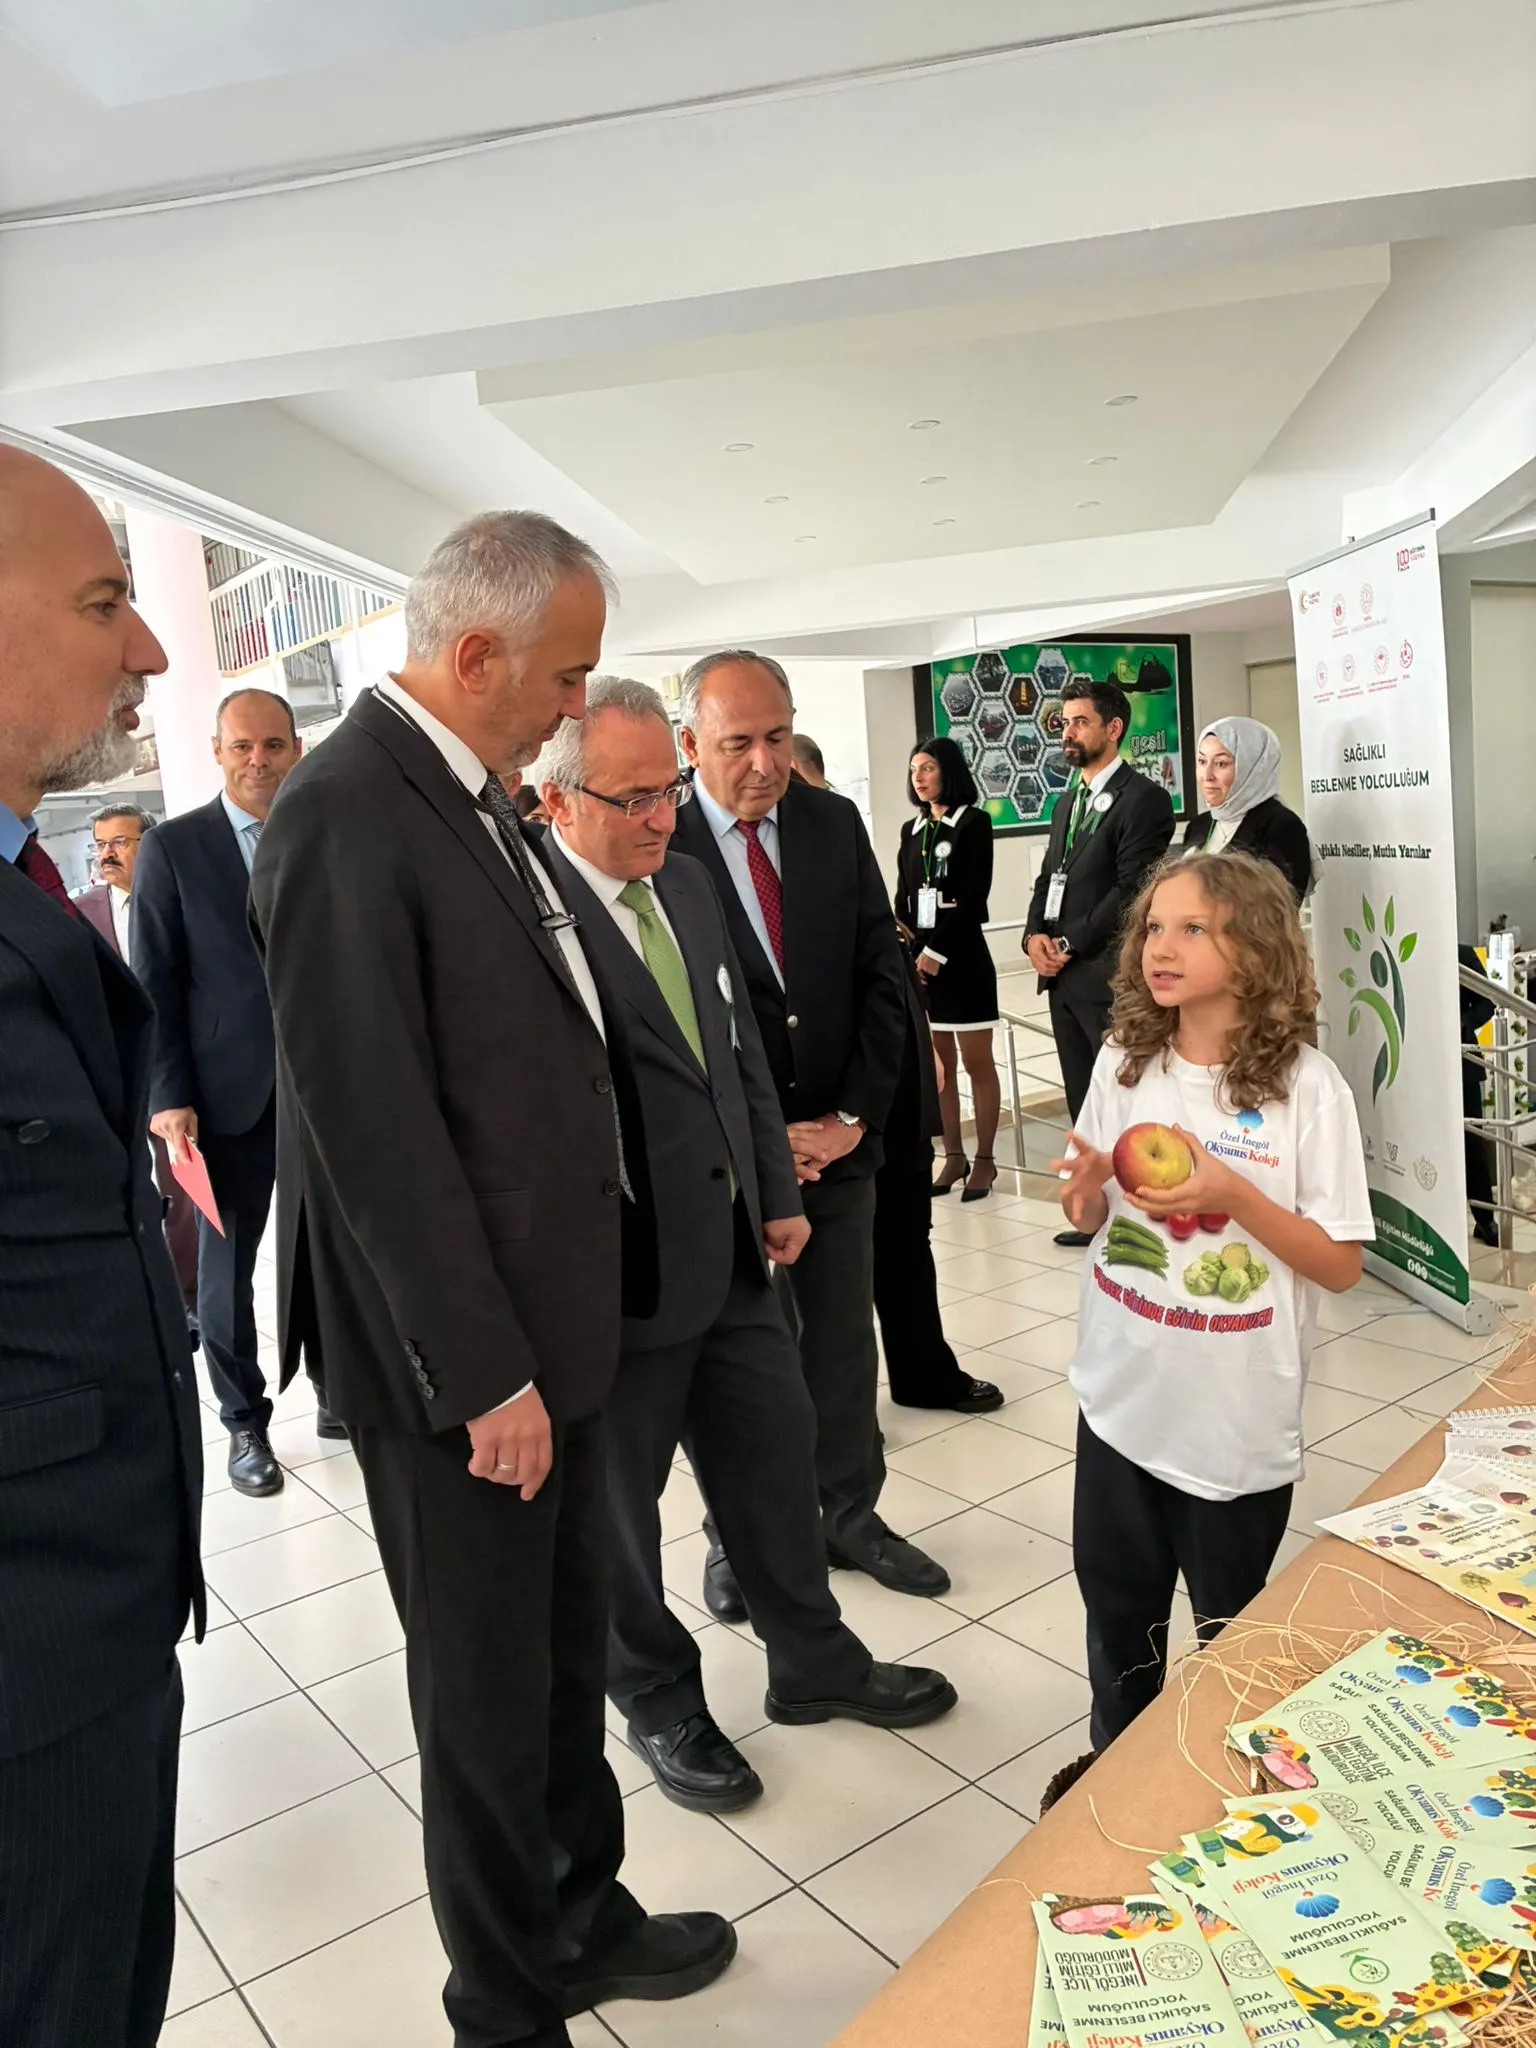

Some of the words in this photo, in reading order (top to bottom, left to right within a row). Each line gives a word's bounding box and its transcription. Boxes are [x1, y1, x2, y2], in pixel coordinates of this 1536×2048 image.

[1131, 730, 1166, 757] yeşil
[1343, 743, 1386, 763] SAĞLIKLI
[1311, 776, 1357, 793] BESLENME
[1359, 768, 1430, 790] YOLCULUĞUM
[1342, 843, 1372, 860] Nesiller,
[1373, 844, 1397, 858] Mutlu
[1399, 844, 1432, 859] Yarınlar
[1220, 1129, 1240, 1143] Özel
[1242, 1135, 1270, 1150] İnegöl
[1205, 1140, 1248, 1159] Okyanus
[1248, 1149, 1280, 1168] Koleji
[1165, 1306, 1208, 1332] EĞİTİM
[1329, 1682, 1362, 1699] SAĞLI
[1366, 1671, 1391, 1686] Özel
[1412, 1702, 1435, 1722] Özel
[1361, 1714, 1412, 1763] YOLCULUĞUM
[1368, 1703, 1400, 1733] SAĞLIKLI
[1396, 1728, 1436, 1769] BESLENME
[1386, 1696, 1426, 1733] Okyanus
[1421, 1731, 1455, 1760] Koleji
[1350, 1738, 1379, 1764] İNEGÖL
[1372, 1761, 1395, 1779] İLÇE
[1384, 1789, 1411, 1819] SAĞLIKLI
[1406, 1784, 1441, 1820] Okyanus
[1433, 1791, 1455, 1810] Özel
[1448, 1807, 1476, 1833] İnegöl
[1374, 1799, 1405, 1832] YOLCULU
[1281, 1852, 1349, 1878] Okyanus
[1403, 1843, 1425, 1879] SAĞLIKLI
[1427, 1845, 1457, 1887] Okyanus
[1454, 1861, 1475, 1881] Özel
[1232, 1871, 1281, 1894] Koleji
[1308, 1871, 1339, 1885] Özel
[1262, 1882, 1306, 1900] İnegöl
[1444, 1882, 1470, 1911] İnegöl
[1290, 1911, 1381, 1943] YOLCULUĞUM
[1350, 1915, 1408, 1940] SAĞLIKLI
[1055, 1948, 1130, 1965] MÜDÜRLÜĞÜ
[1281, 1934, 1350, 1960] BESLENME
[1059, 1963, 1101, 1978] EĞİTİM
[1092, 1974, 1140, 1992] İNEGÖL
[1063, 1977, 1091, 1992] İLÇE
[1087, 1993, 1188, 2014] YOLCULUĞUM
[1148, 2003, 1212, 2022] SAĞLIKLI
[1072, 2014, 1146, 2027] BESLENME
[1144, 2020, 1225, 2043] Okyanus
